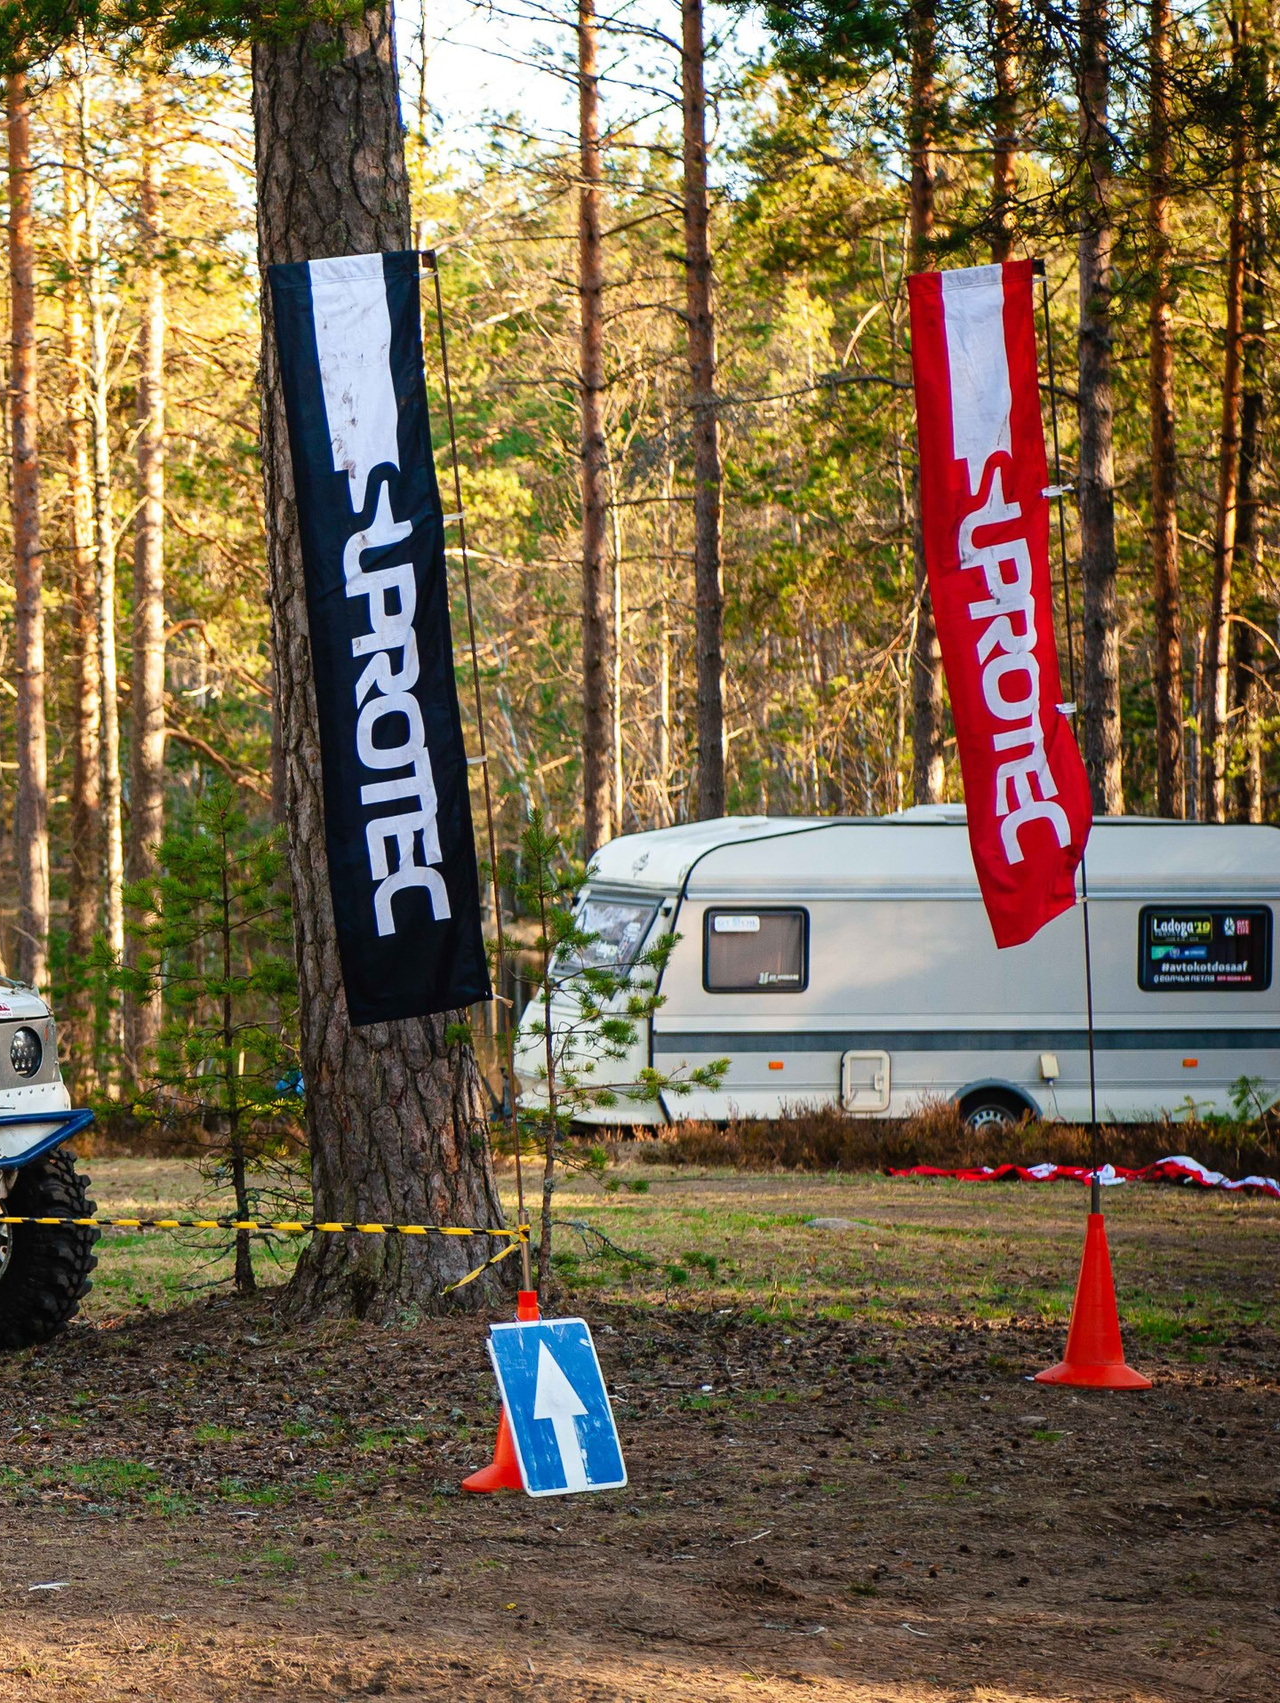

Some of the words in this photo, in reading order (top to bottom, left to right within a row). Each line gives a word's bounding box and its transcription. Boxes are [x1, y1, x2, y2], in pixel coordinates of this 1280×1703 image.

[343, 462, 452, 936] SUPROTEC
[958, 450, 1072, 865] SUPROTEC
[1161, 961, 1248, 973] #avtokotdosaaf
